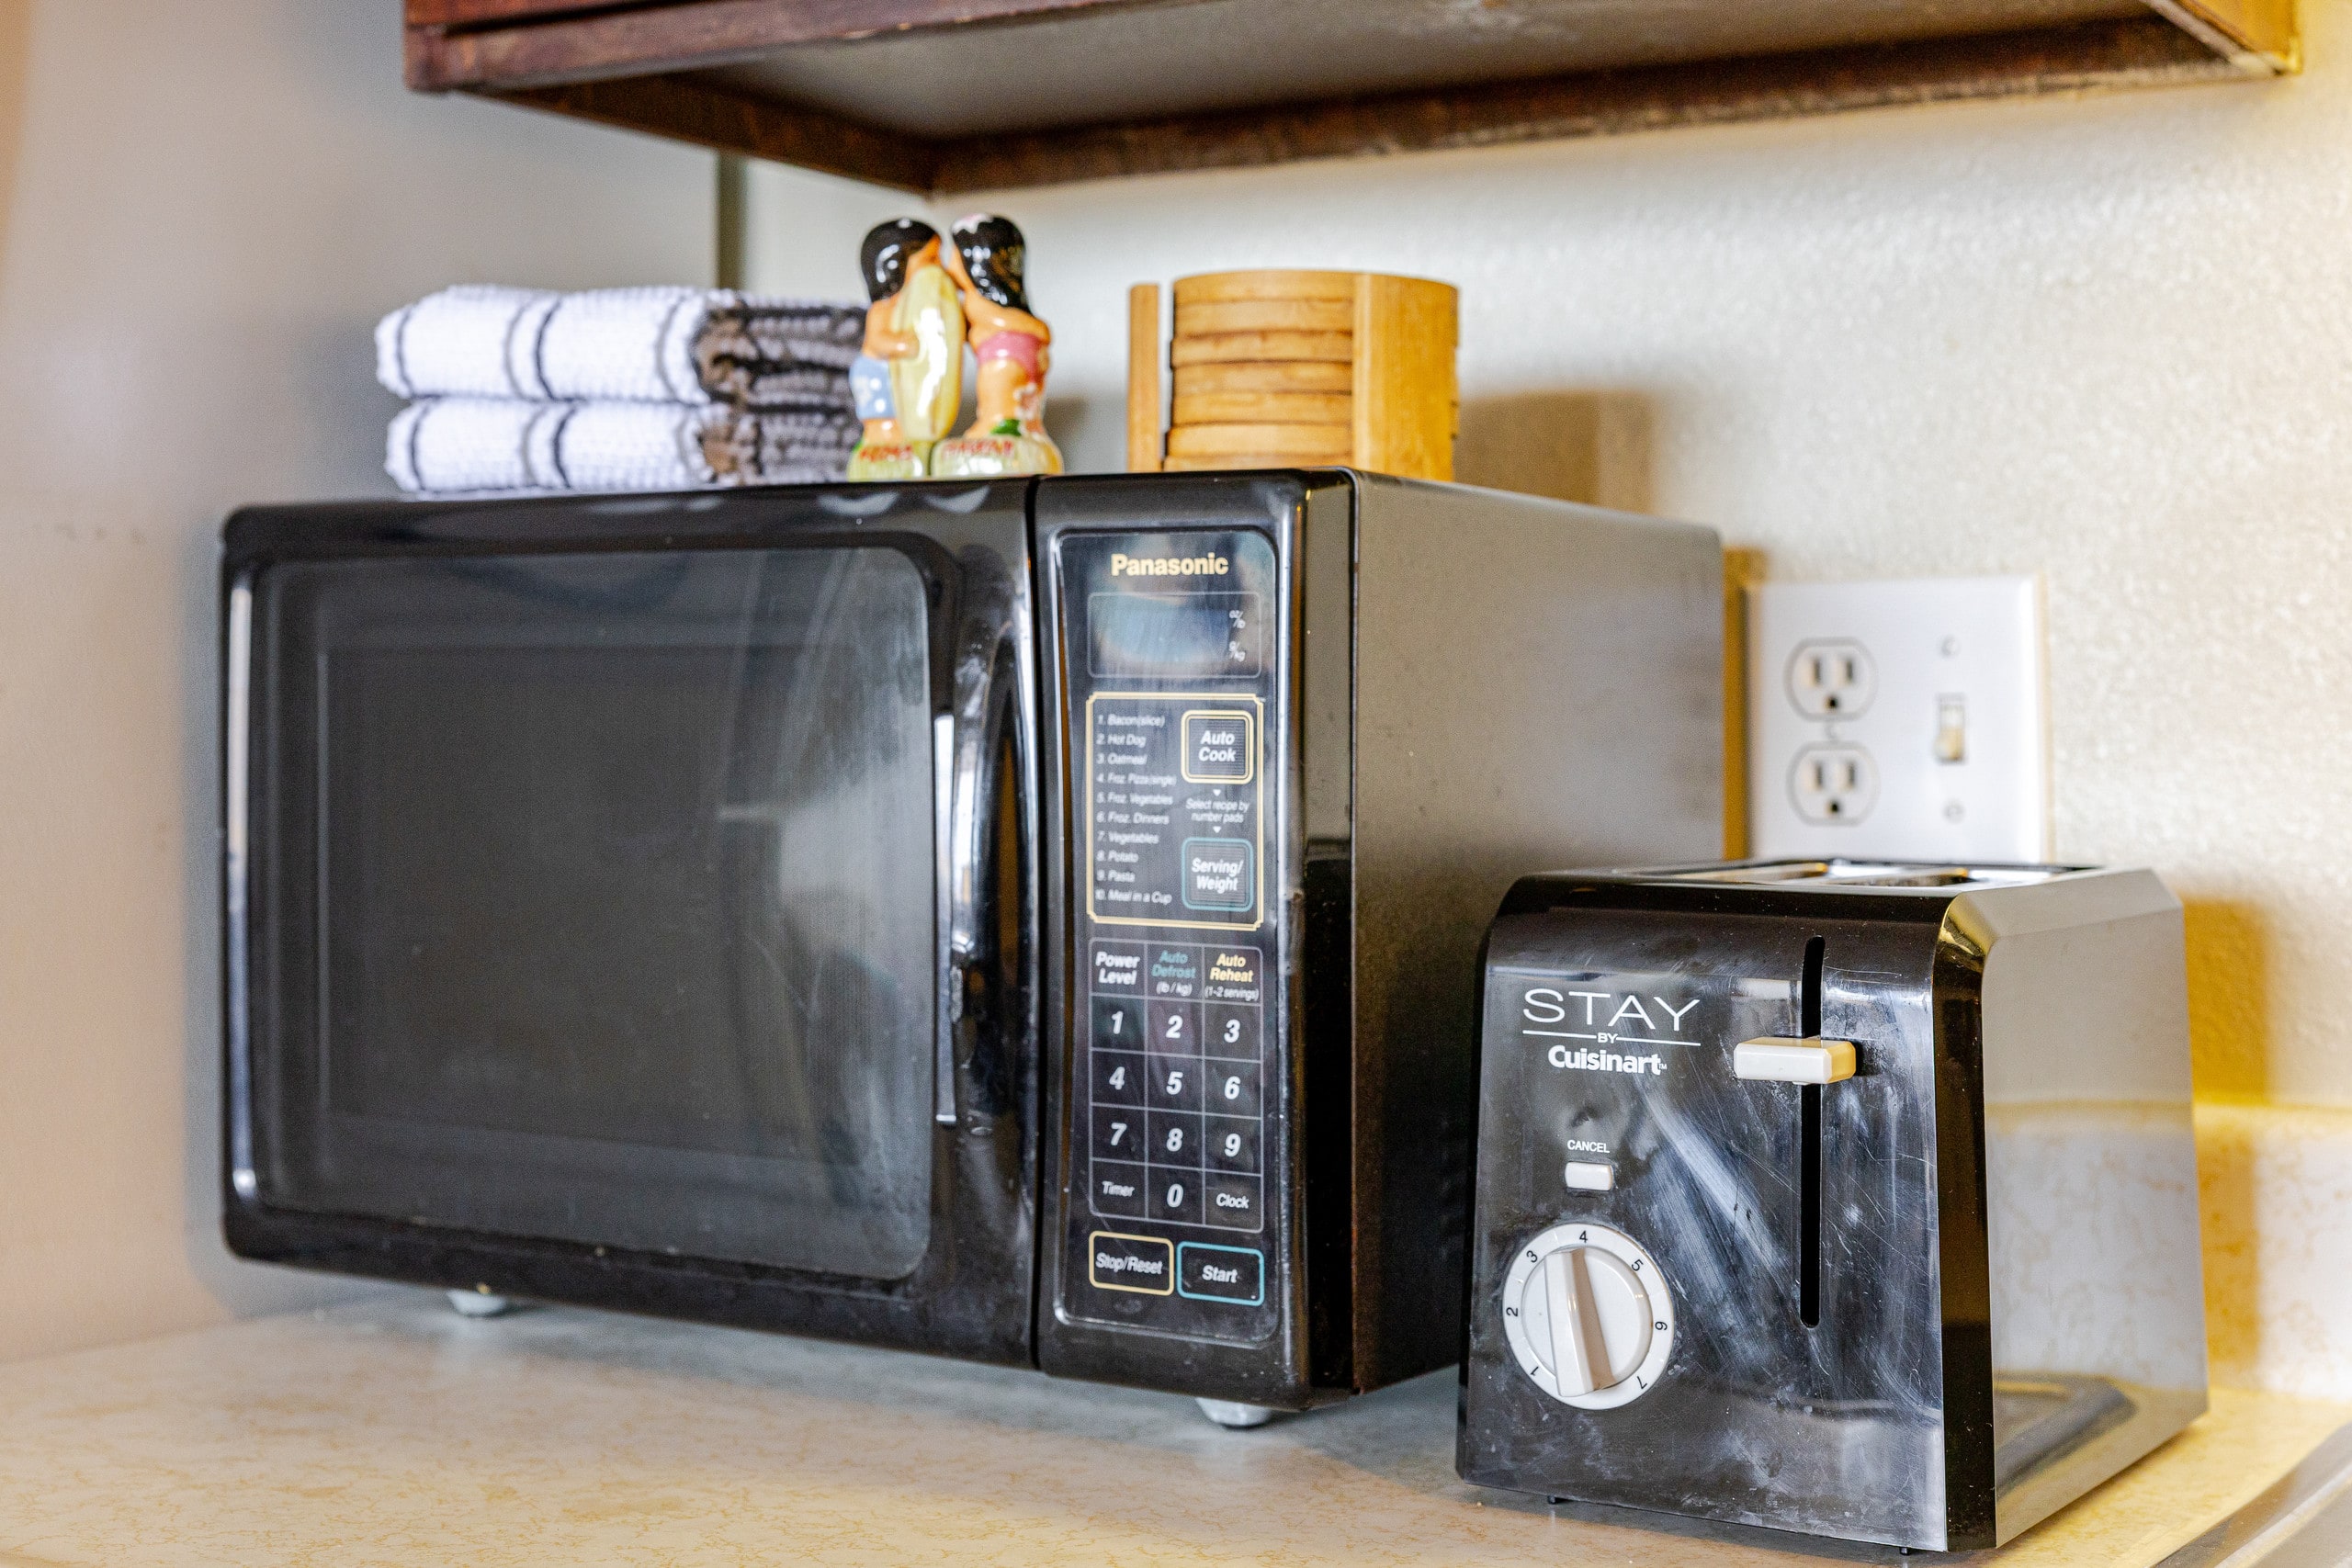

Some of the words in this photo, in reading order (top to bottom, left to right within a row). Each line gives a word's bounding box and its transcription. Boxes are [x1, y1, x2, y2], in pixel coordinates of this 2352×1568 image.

[1110, 552, 1229, 576] Panasonic
[1126, 734, 1147, 748] Dog
[1200, 730, 1236, 745] Auto
[1198, 747, 1237, 762] Cook
[1186, 797, 1212, 809] Select
[1192, 857, 1244, 877] Serving/
[1196, 875, 1238, 894] Weight
[1151, 890, 1172, 905] Cup
[1095, 951, 1140, 968] Power
[1159, 950, 1188, 964] Auto
[1216, 953, 1247, 967] Auto
[1099, 968, 1137, 985] Level
[1151, 964, 1197, 978] Defrost
[1209, 967, 1254, 983] Reheat
[1522, 987, 1701, 1032] STAY
[1111, 1010, 1125, 1035] 1
[1165, 1015, 1183, 1039] 2
[1223, 1019, 1241, 1043] 3
[1597, 1032, 1618, 1043] BY
[1547, 1044, 1661, 1076] Cuisinart
[1108, 1066, 1126, 1090] 4
[1166, 1071, 1184, 1095] 5
[1224, 1076, 1241, 1100] 6
[1110, 1122, 1128, 1146] 7
[1166, 1127, 1184, 1152] 8
[1224, 1133, 1241, 1157] 9
[1566, 1139, 1611, 1154] CANCEL
[1102, 1180, 1136, 1197] Timer
[1166, 1183, 1184, 1208] 0
[1216, 1192, 1250, 1209] Clock
[1578, 1230, 1589, 1244] 4
[1095, 1252, 1163, 1275] Stop/Reset
[1526, 1250, 1539, 1263] 3
[1631, 1258, 1645, 1272] 5
[1202, 1264, 1238, 1283] Start
[1506, 1306, 1519, 1317] 2
[1530, 1366, 1540, 1376] 1
[1636, 1376, 1648, 1390] 7
